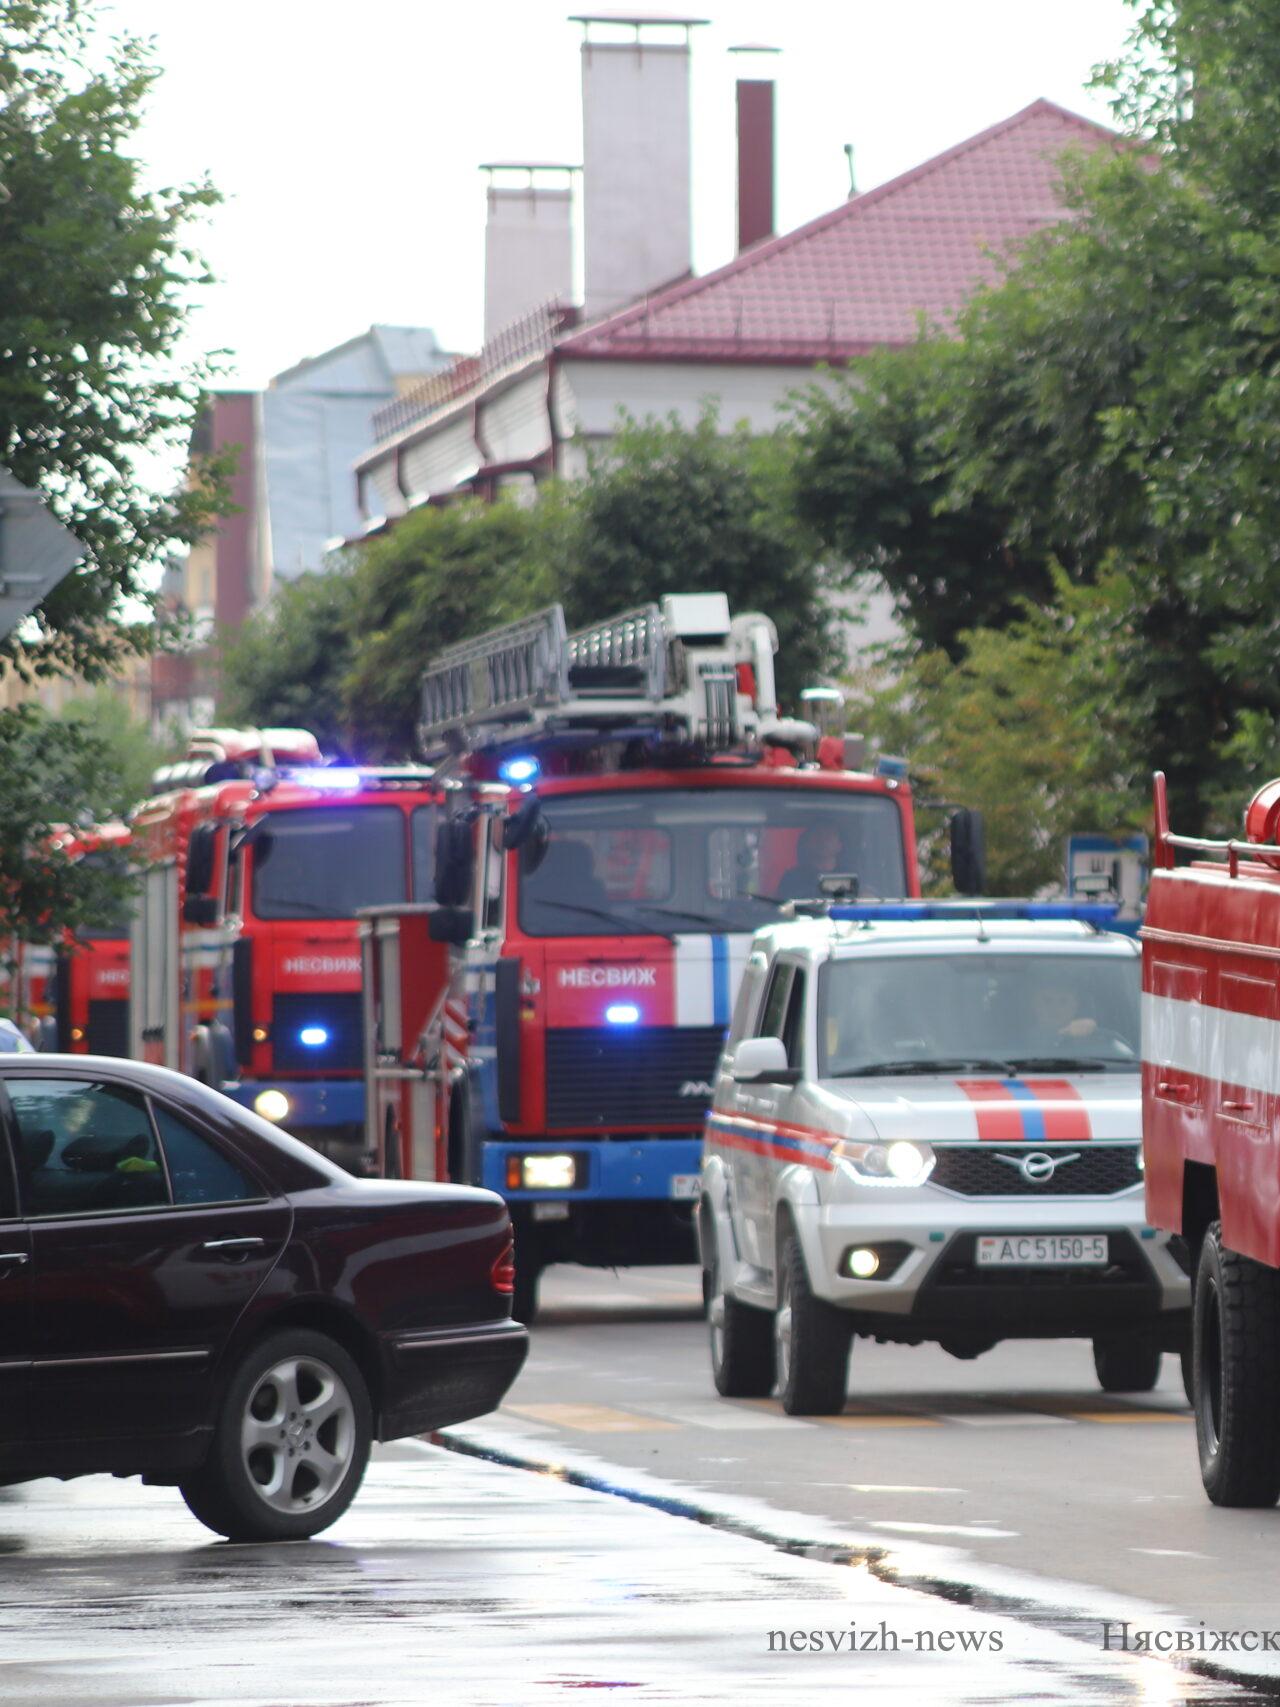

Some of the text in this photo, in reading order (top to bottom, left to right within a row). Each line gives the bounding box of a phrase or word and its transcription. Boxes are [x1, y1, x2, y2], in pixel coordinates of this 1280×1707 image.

[284, 957, 362, 974] НЕСВИЖ
[98, 969, 130, 984] НЕС
[560, 968, 656, 986] НЕСВИЖ
[1035, 1239, 1104, 1259] 5150-5
